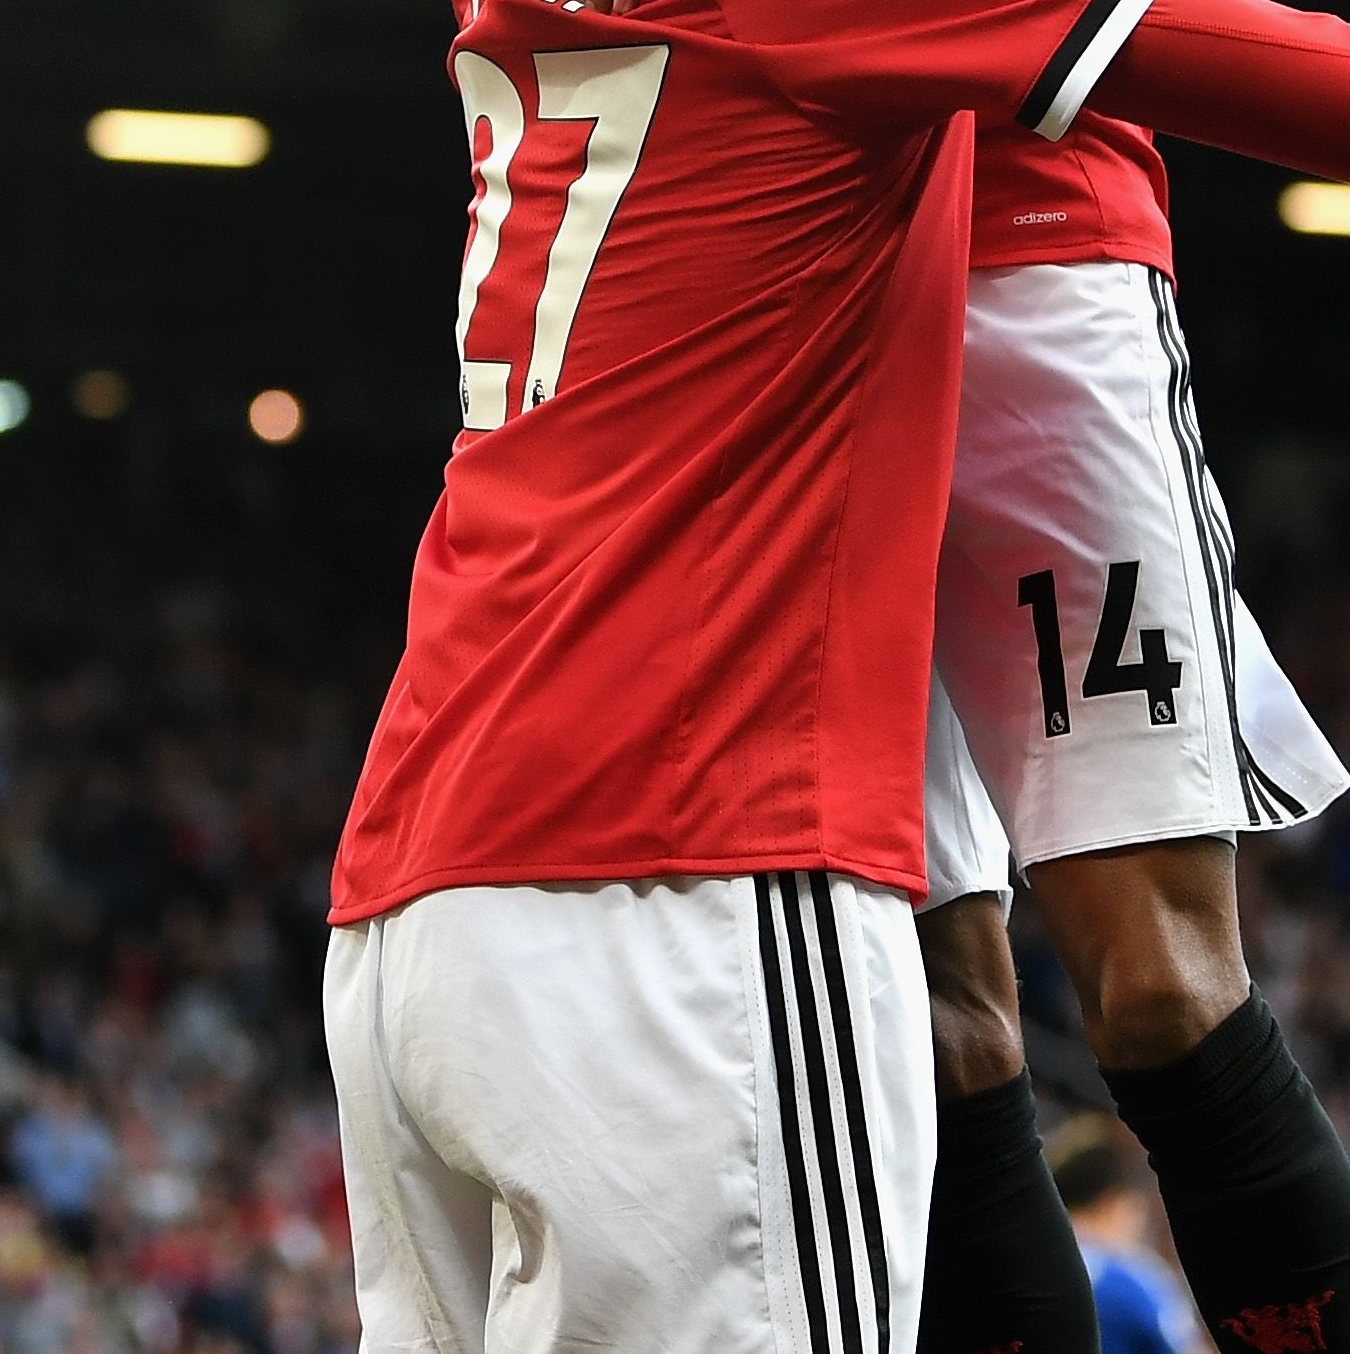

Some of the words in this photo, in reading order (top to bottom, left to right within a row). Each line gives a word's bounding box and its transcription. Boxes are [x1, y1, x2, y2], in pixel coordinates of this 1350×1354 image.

[454, 44, 670, 432] 27
[1013, 211, 1067, 226] adizero
[1017, 560, 1184, 738] 14
